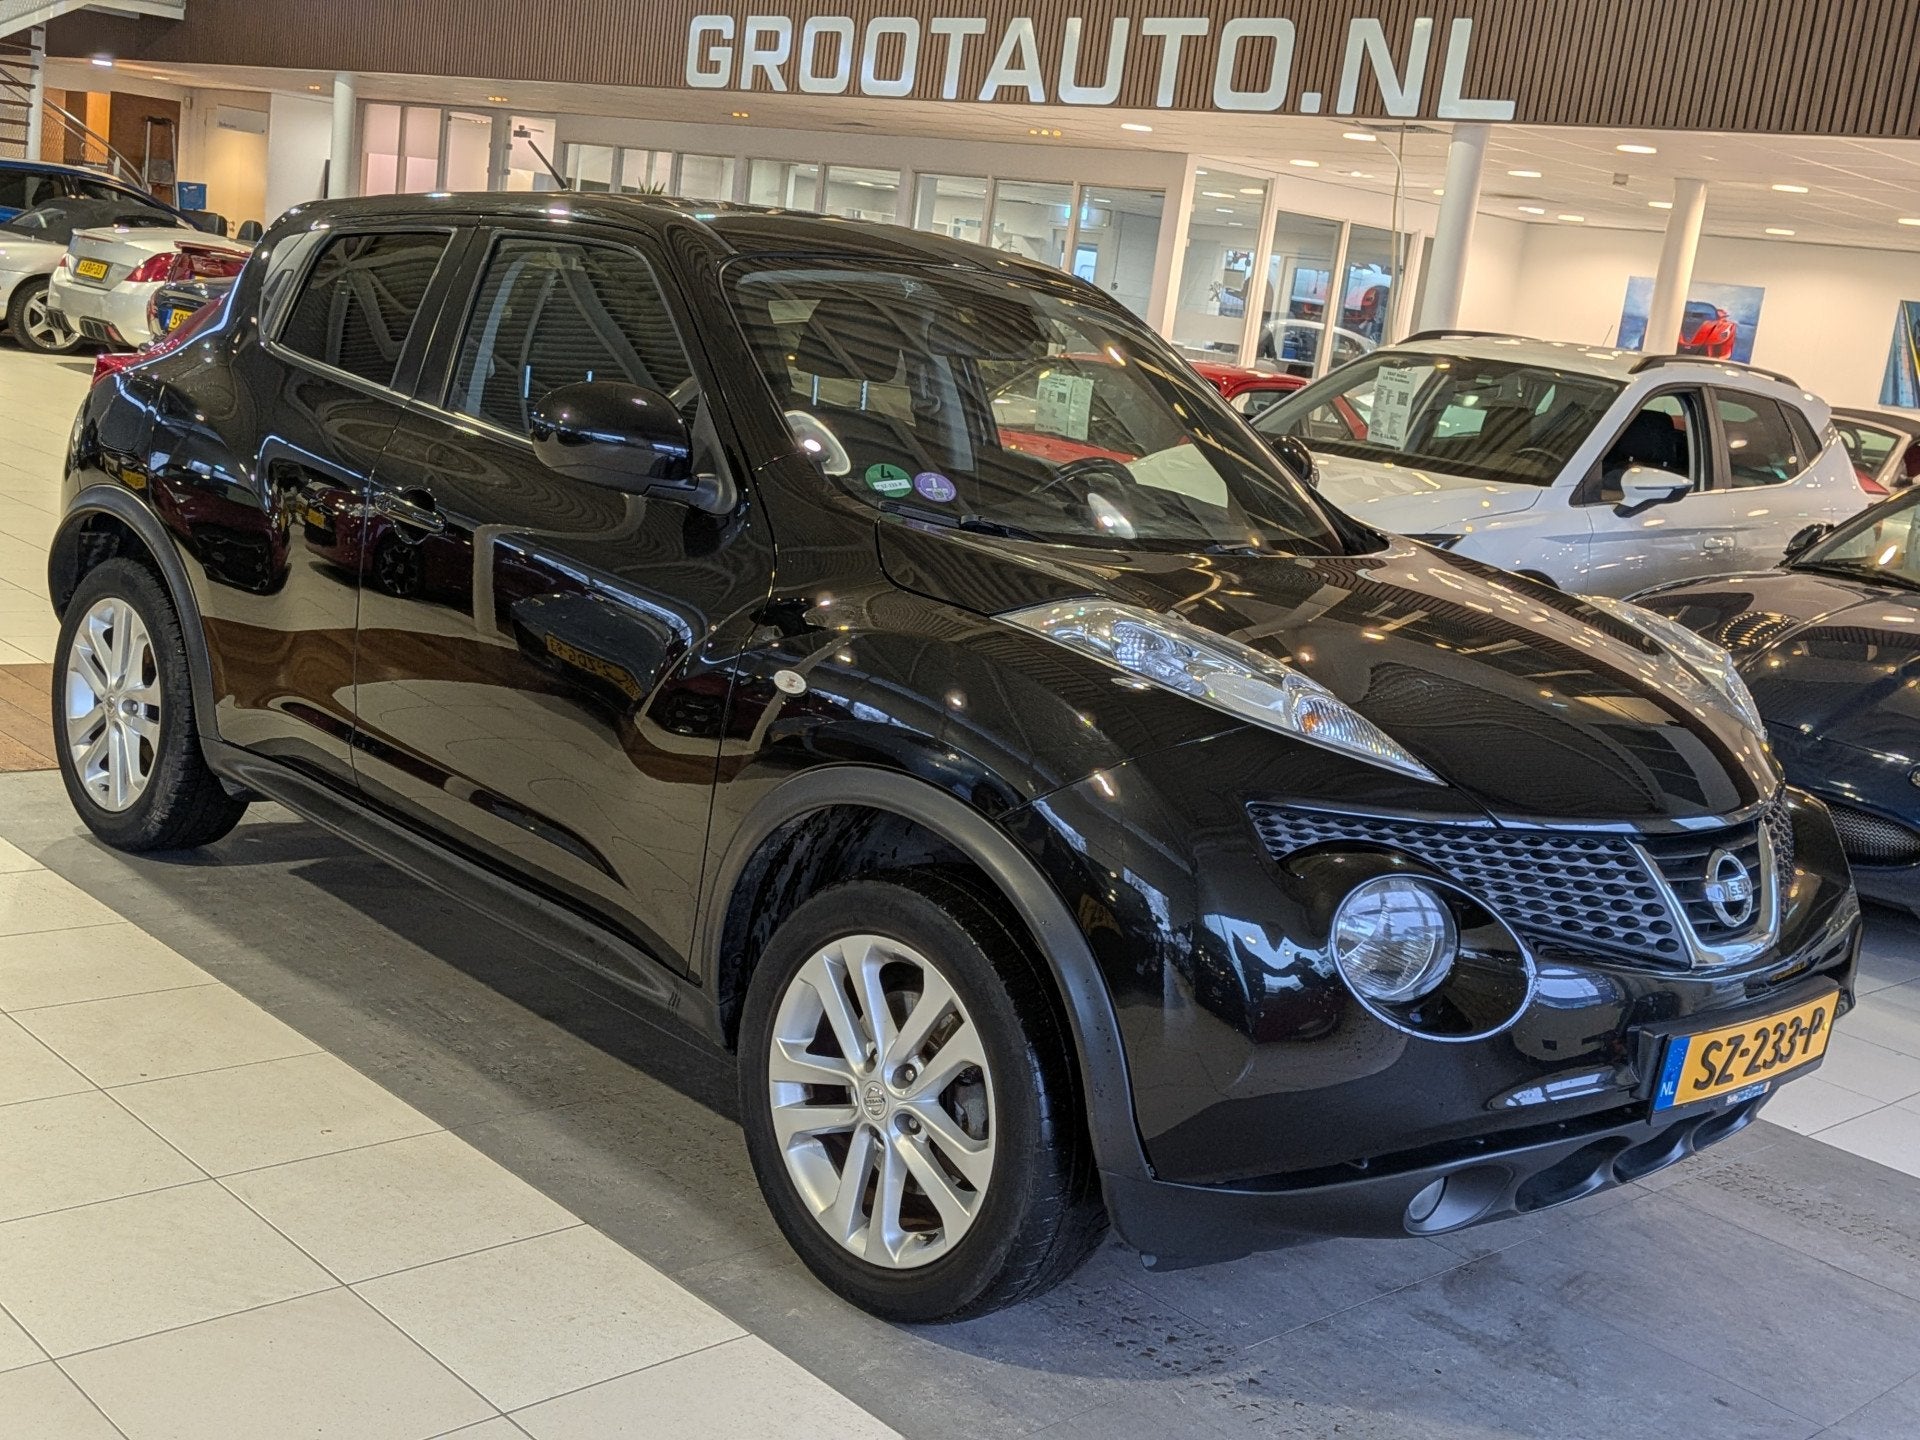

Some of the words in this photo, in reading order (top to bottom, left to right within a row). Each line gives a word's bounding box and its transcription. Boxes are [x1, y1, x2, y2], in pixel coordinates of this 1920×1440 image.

[686, 15, 1515, 121] GROOTAUTO.NL
[1660, 1081, 1674, 1097] NL
[1693, 1007, 1826, 1090] SZ-233-P
